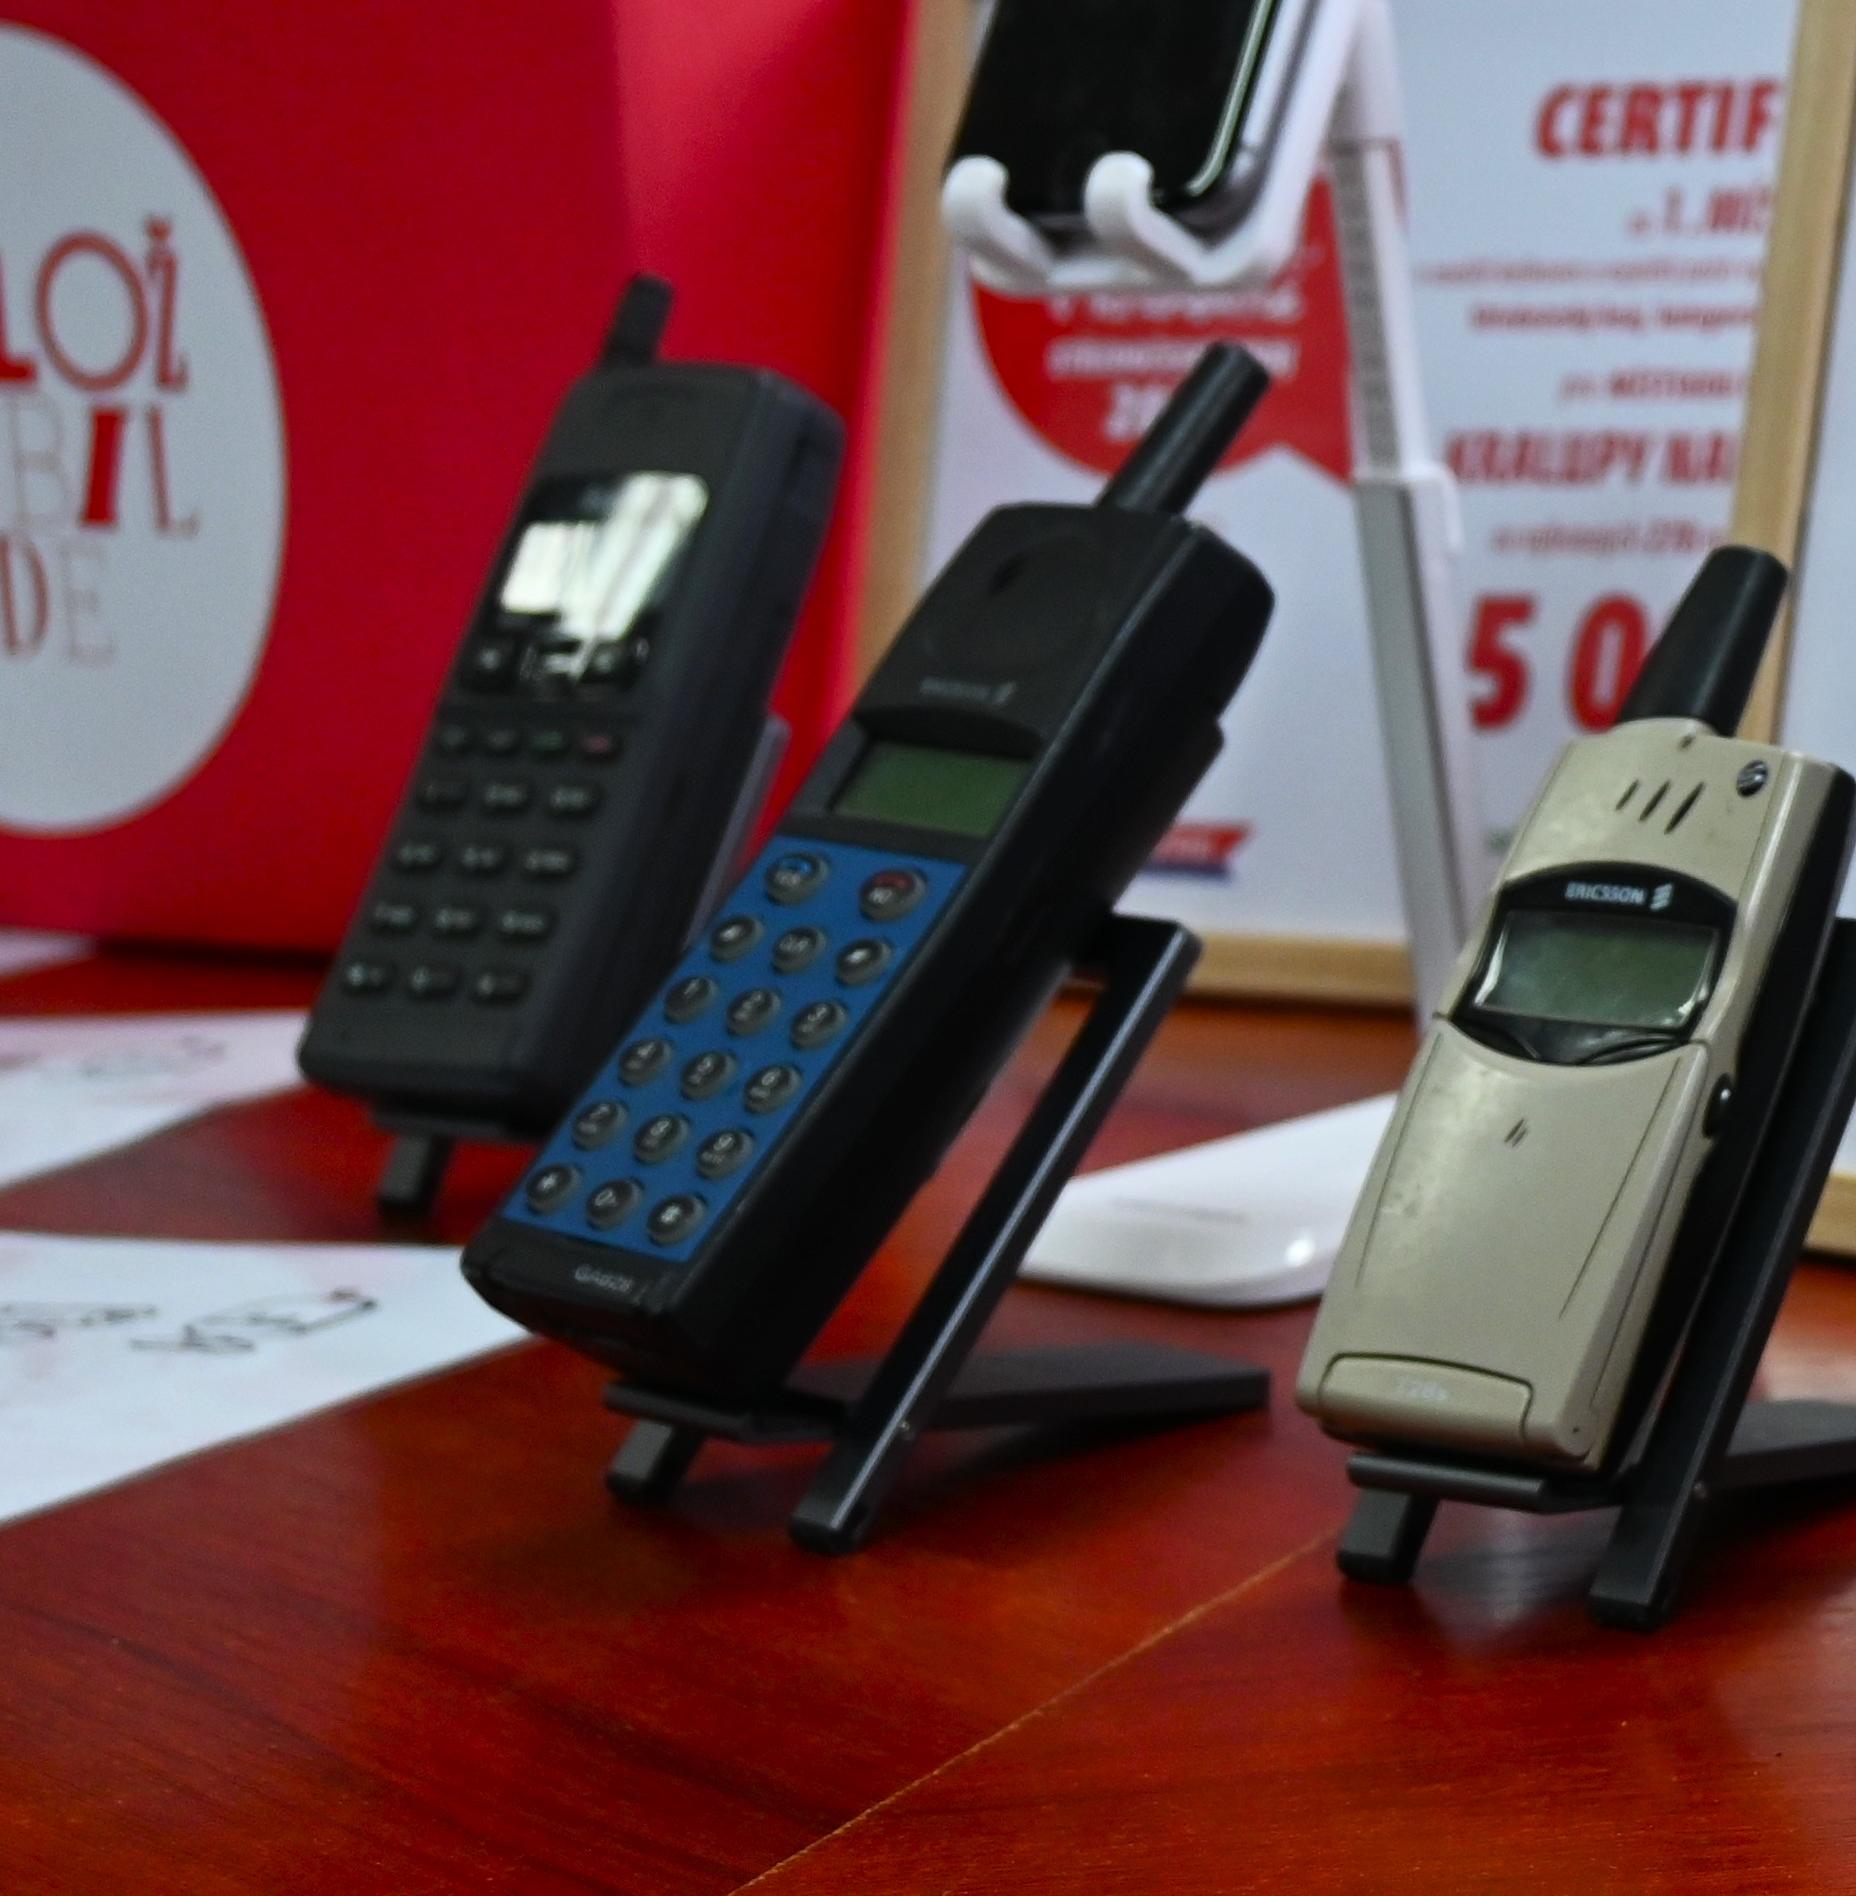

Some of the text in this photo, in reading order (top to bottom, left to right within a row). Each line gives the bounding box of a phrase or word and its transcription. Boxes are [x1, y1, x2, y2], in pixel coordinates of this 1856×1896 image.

[1465, 590, 1650, 735] 5 0
[1564, 881, 1645, 904] ERICSSON
